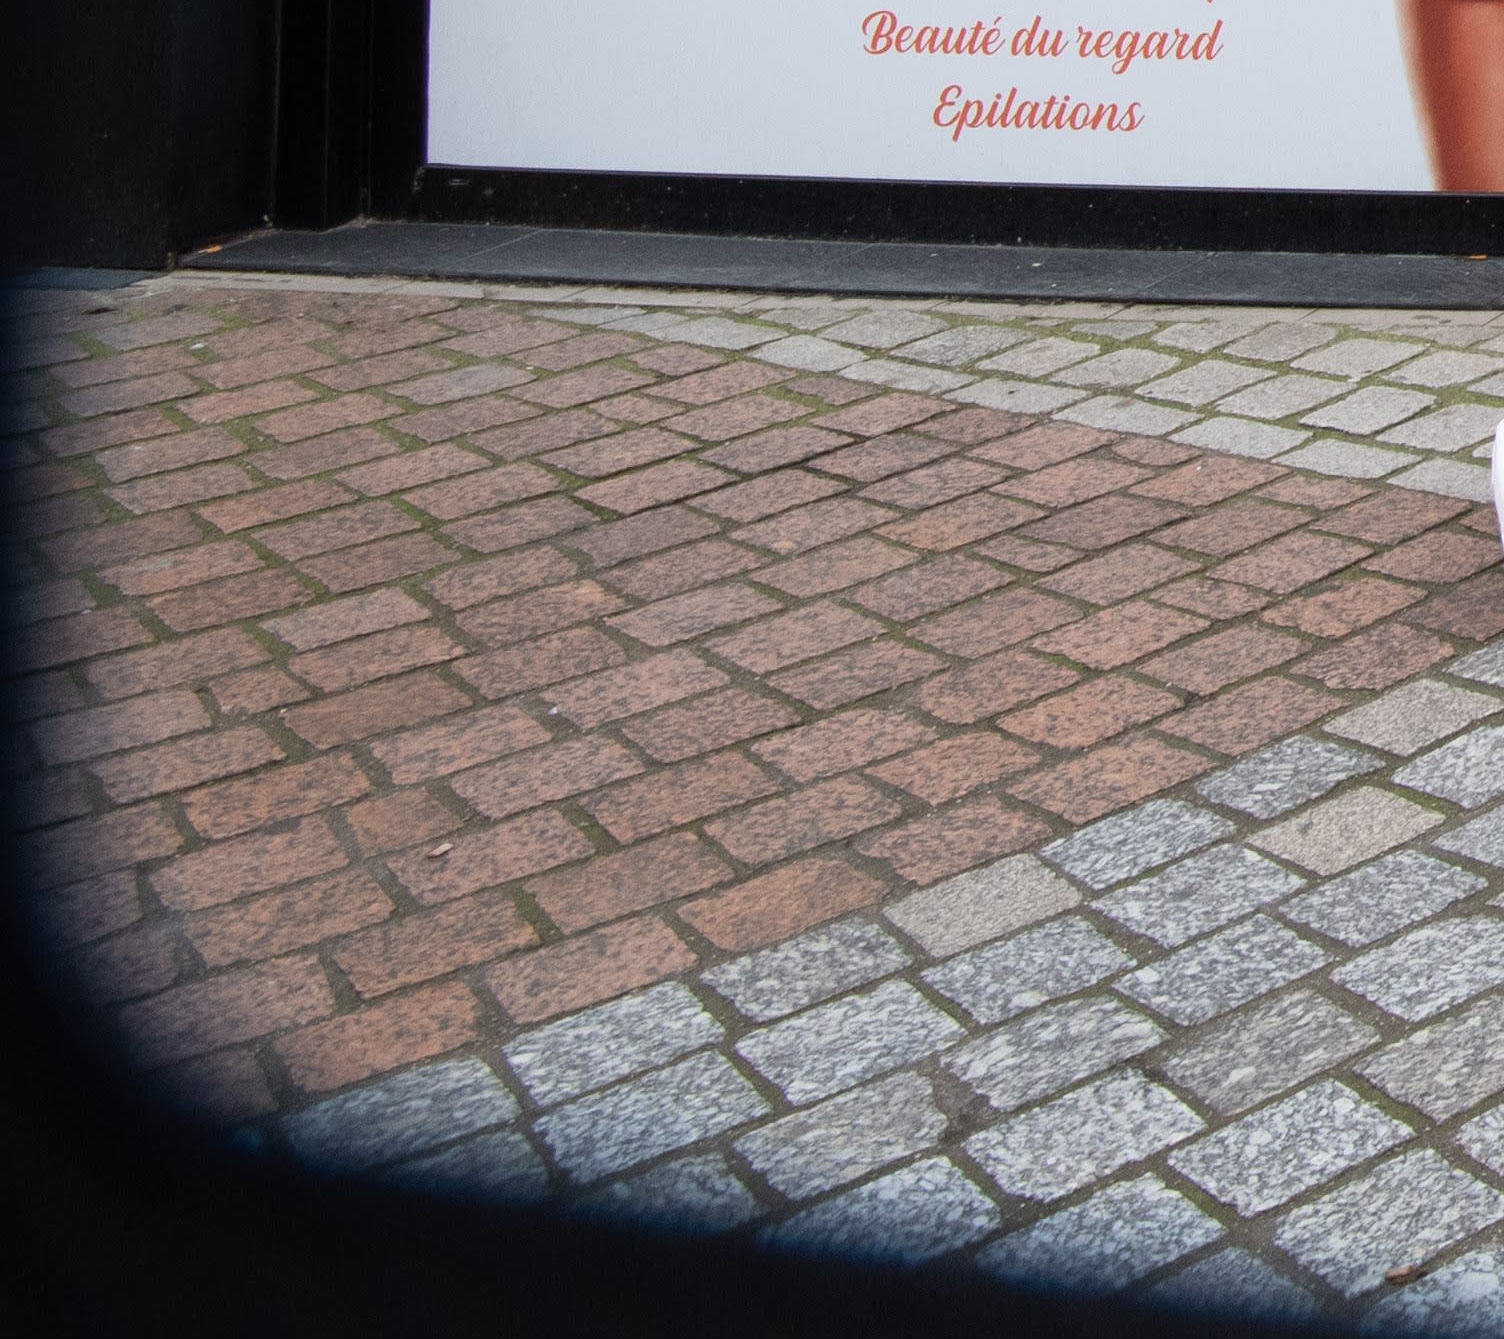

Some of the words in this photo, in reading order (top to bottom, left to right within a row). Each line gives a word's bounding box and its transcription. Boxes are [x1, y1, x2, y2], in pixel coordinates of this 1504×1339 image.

[860, 10, 1001, 56] Beauté
[1009, 15, 1062, 58] du
[1076, 20, 1223, 75] regard
[931, 85, 1142, 142] Epilations
